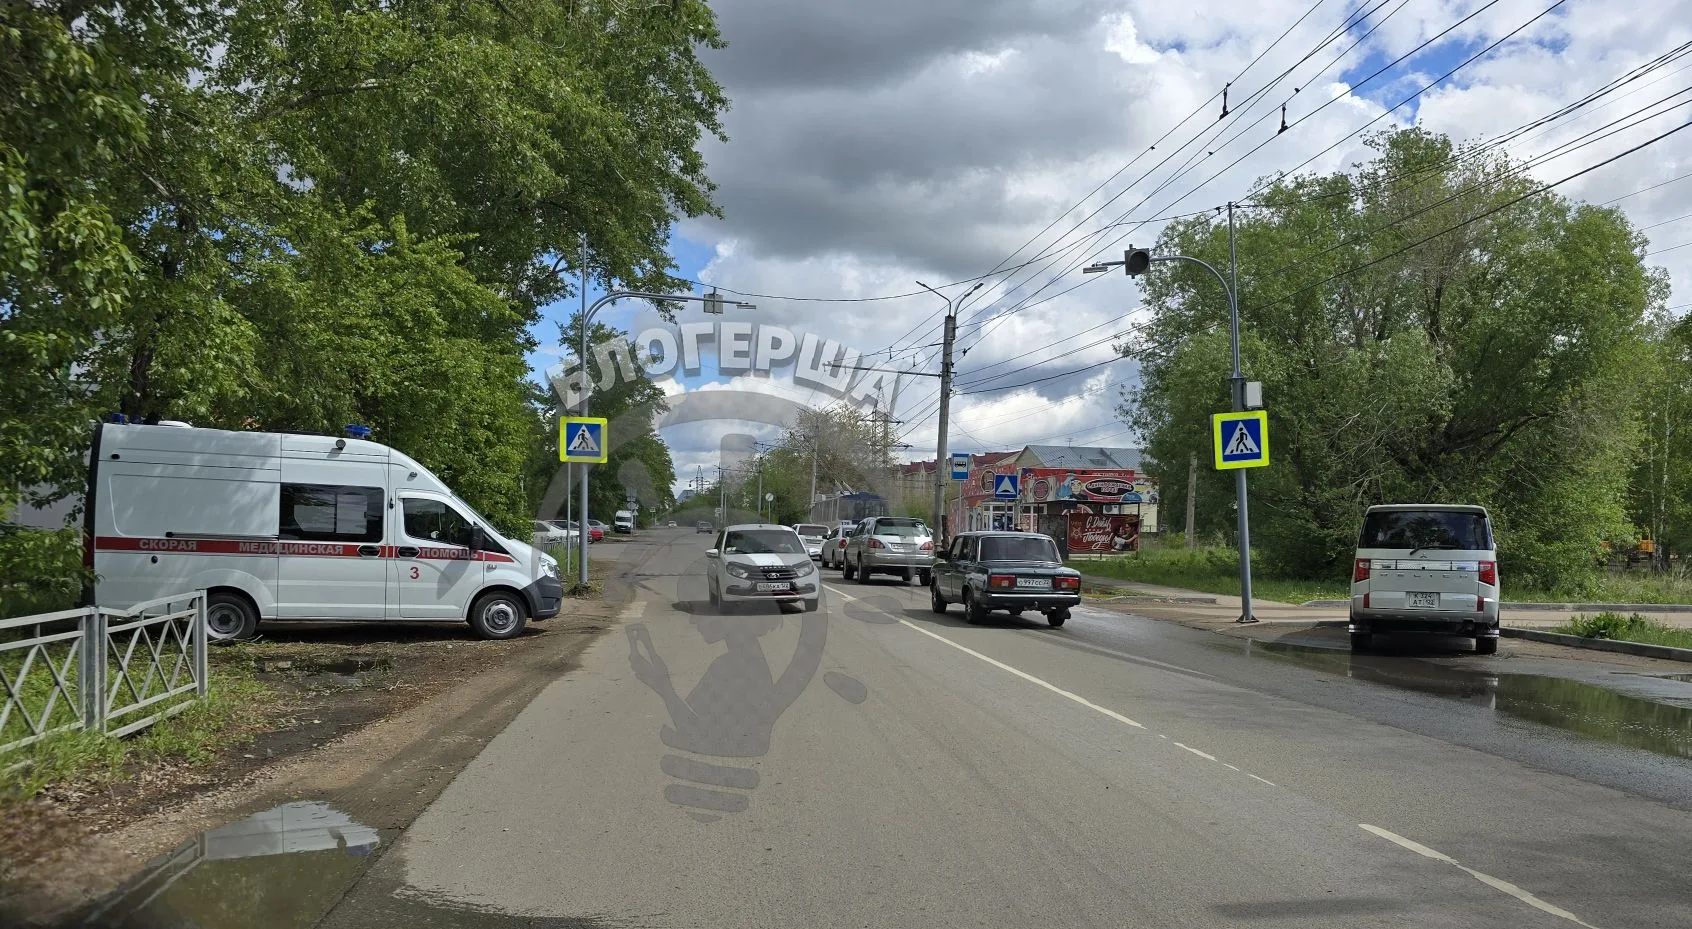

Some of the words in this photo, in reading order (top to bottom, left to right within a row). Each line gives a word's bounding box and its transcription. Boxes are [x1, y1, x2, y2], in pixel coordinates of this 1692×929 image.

[139, 539, 198, 550] СКОРАЯ
[239, 541, 344, 555] МЕДИЦИНСКАЯ
[421, 547, 478, 560] ПОМОЩЬ
[409, 566, 420, 580] 3
